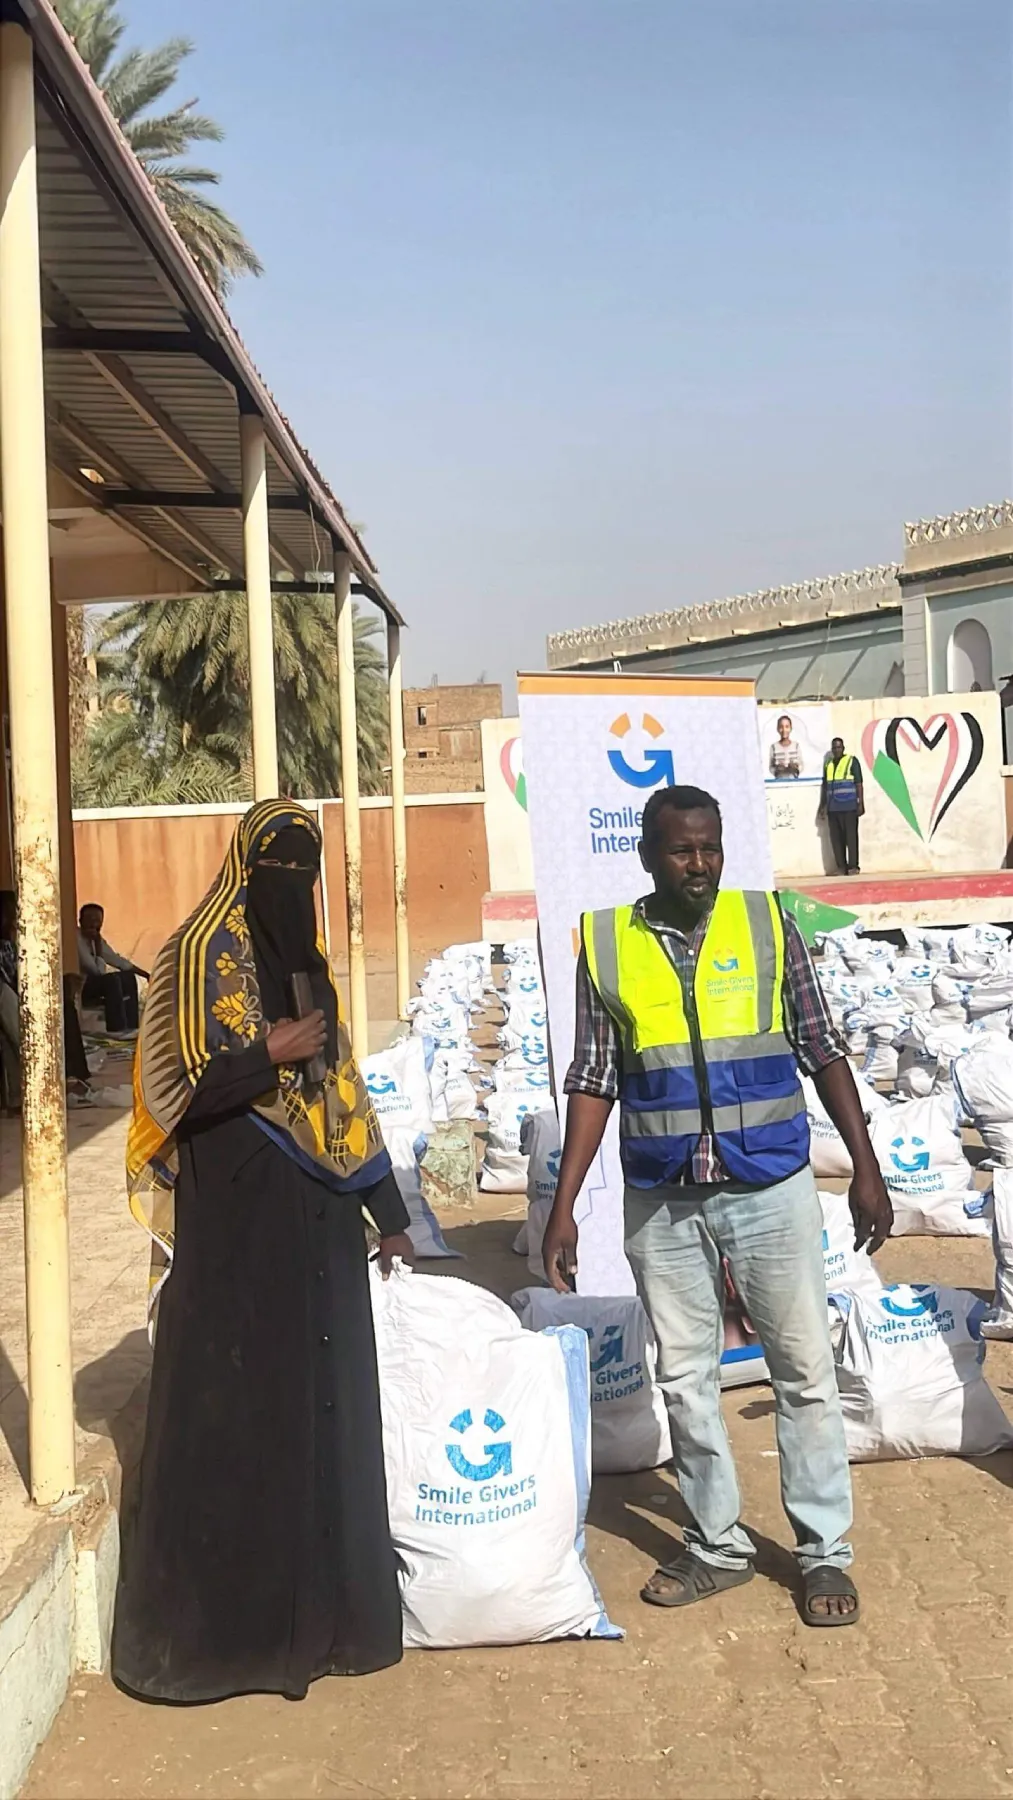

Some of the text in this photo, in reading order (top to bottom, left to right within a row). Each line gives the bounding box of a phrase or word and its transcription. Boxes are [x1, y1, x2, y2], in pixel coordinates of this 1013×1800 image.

[589, 807, 644, 829] Smile
[535, 1180, 556, 1191] Smil
[883, 1174, 908, 1184] mile
[824, 1252, 845, 1266] ers
[595, 1361, 643, 1386] Givers
[592, 1375, 645, 1402] ational
[418, 1474, 537, 1504] Smile Givers
[415, 1491, 537, 1526] International
